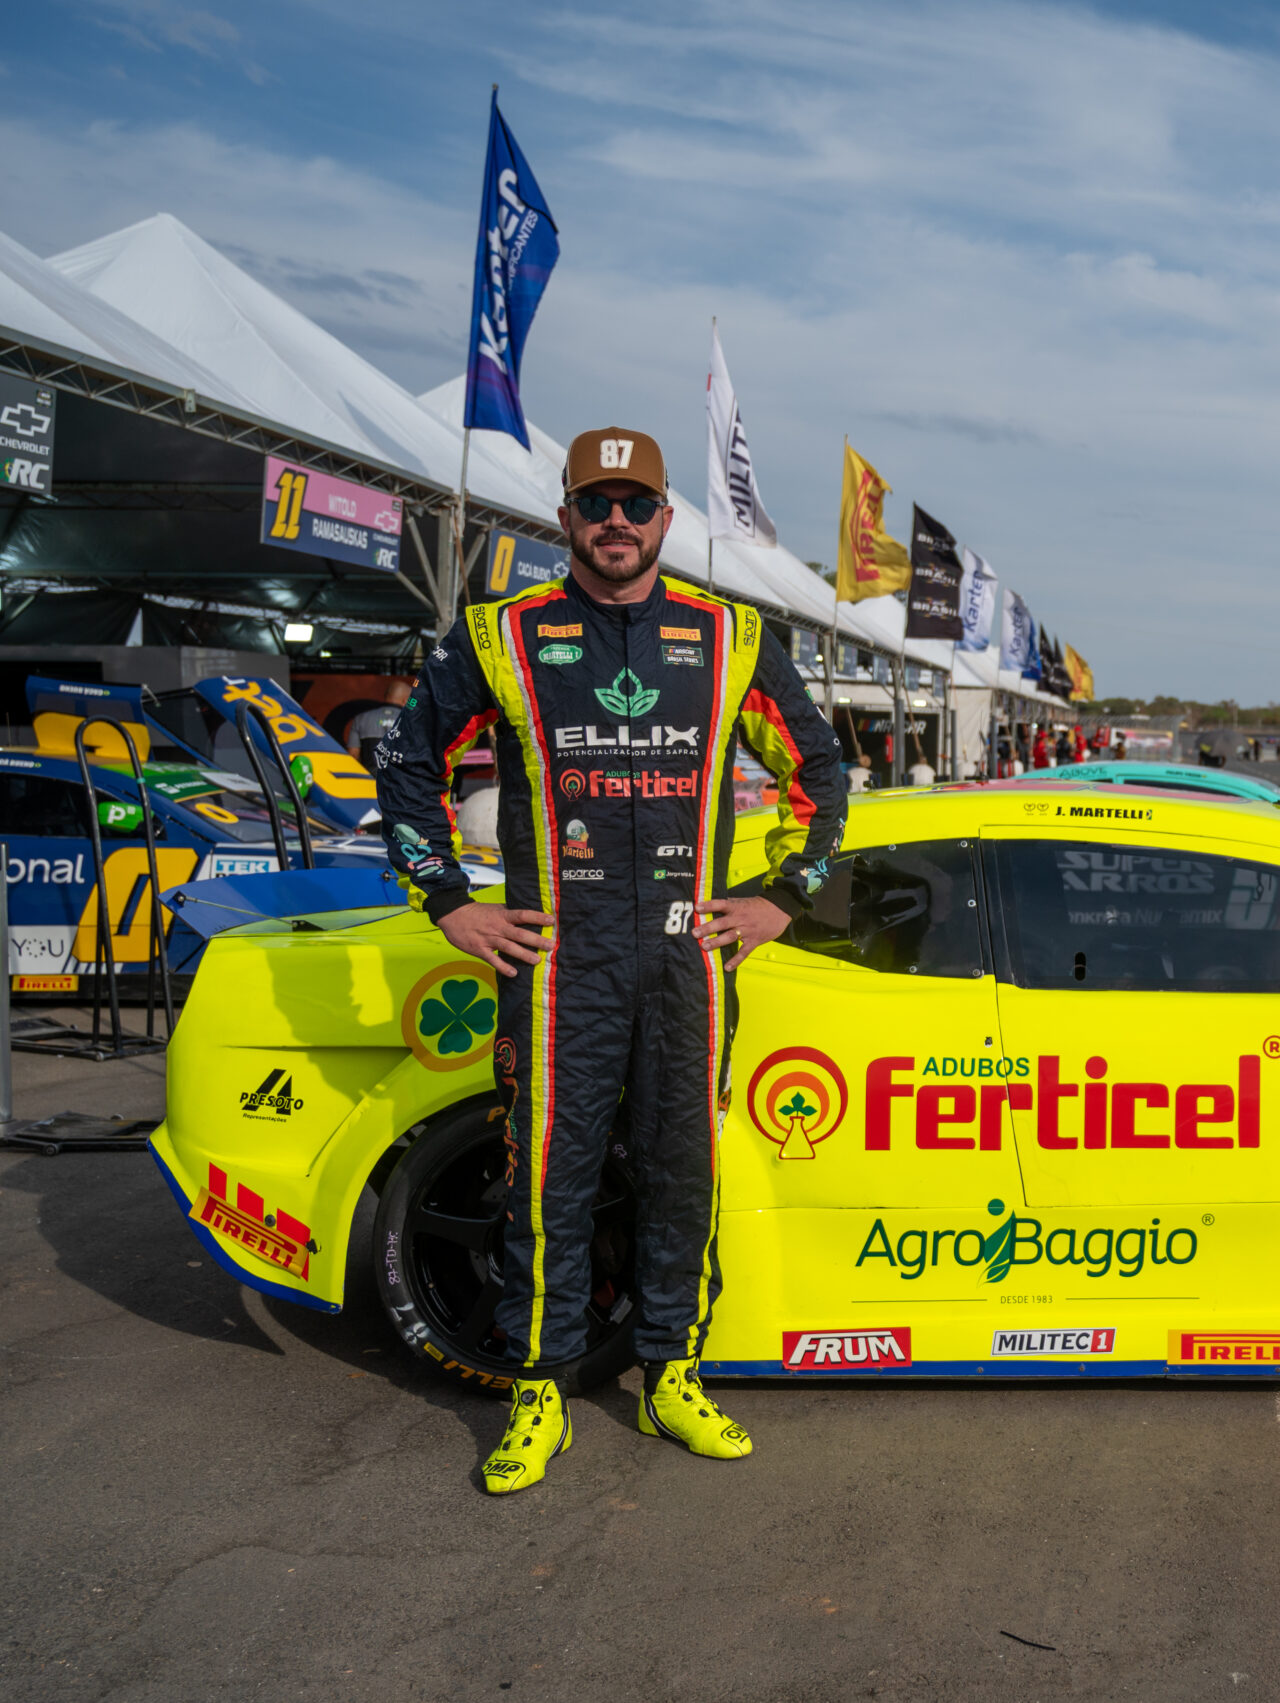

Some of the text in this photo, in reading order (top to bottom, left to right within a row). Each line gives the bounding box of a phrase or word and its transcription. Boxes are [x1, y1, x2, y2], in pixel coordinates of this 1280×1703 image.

[600, 438, 635, 470] 87
[269, 468, 309, 542] 11
[473, 604, 492, 651] sparco
[554, 725, 697, 749] ELLIX
[666, 749, 699, 757] SAFRAS
[1055, 806, 1144, 820] J. MARTELLI
[562, 868, 605, 881] sparco
[664, 900, 694, 935] 87
[19, 976, 73, 989] PIRELLI
[922, 1056, 1030, 1078] ADUBOS
[239, 1091, 304, 1111] PRESOTO
[864, 1054, 1261, 1151] ferticel
[200, 1195, 299, 1269] PIRELLI
[1000, 1295, 1053, 1305] DESDE 1983
[788, 1331, 906, 1365] FRUM
